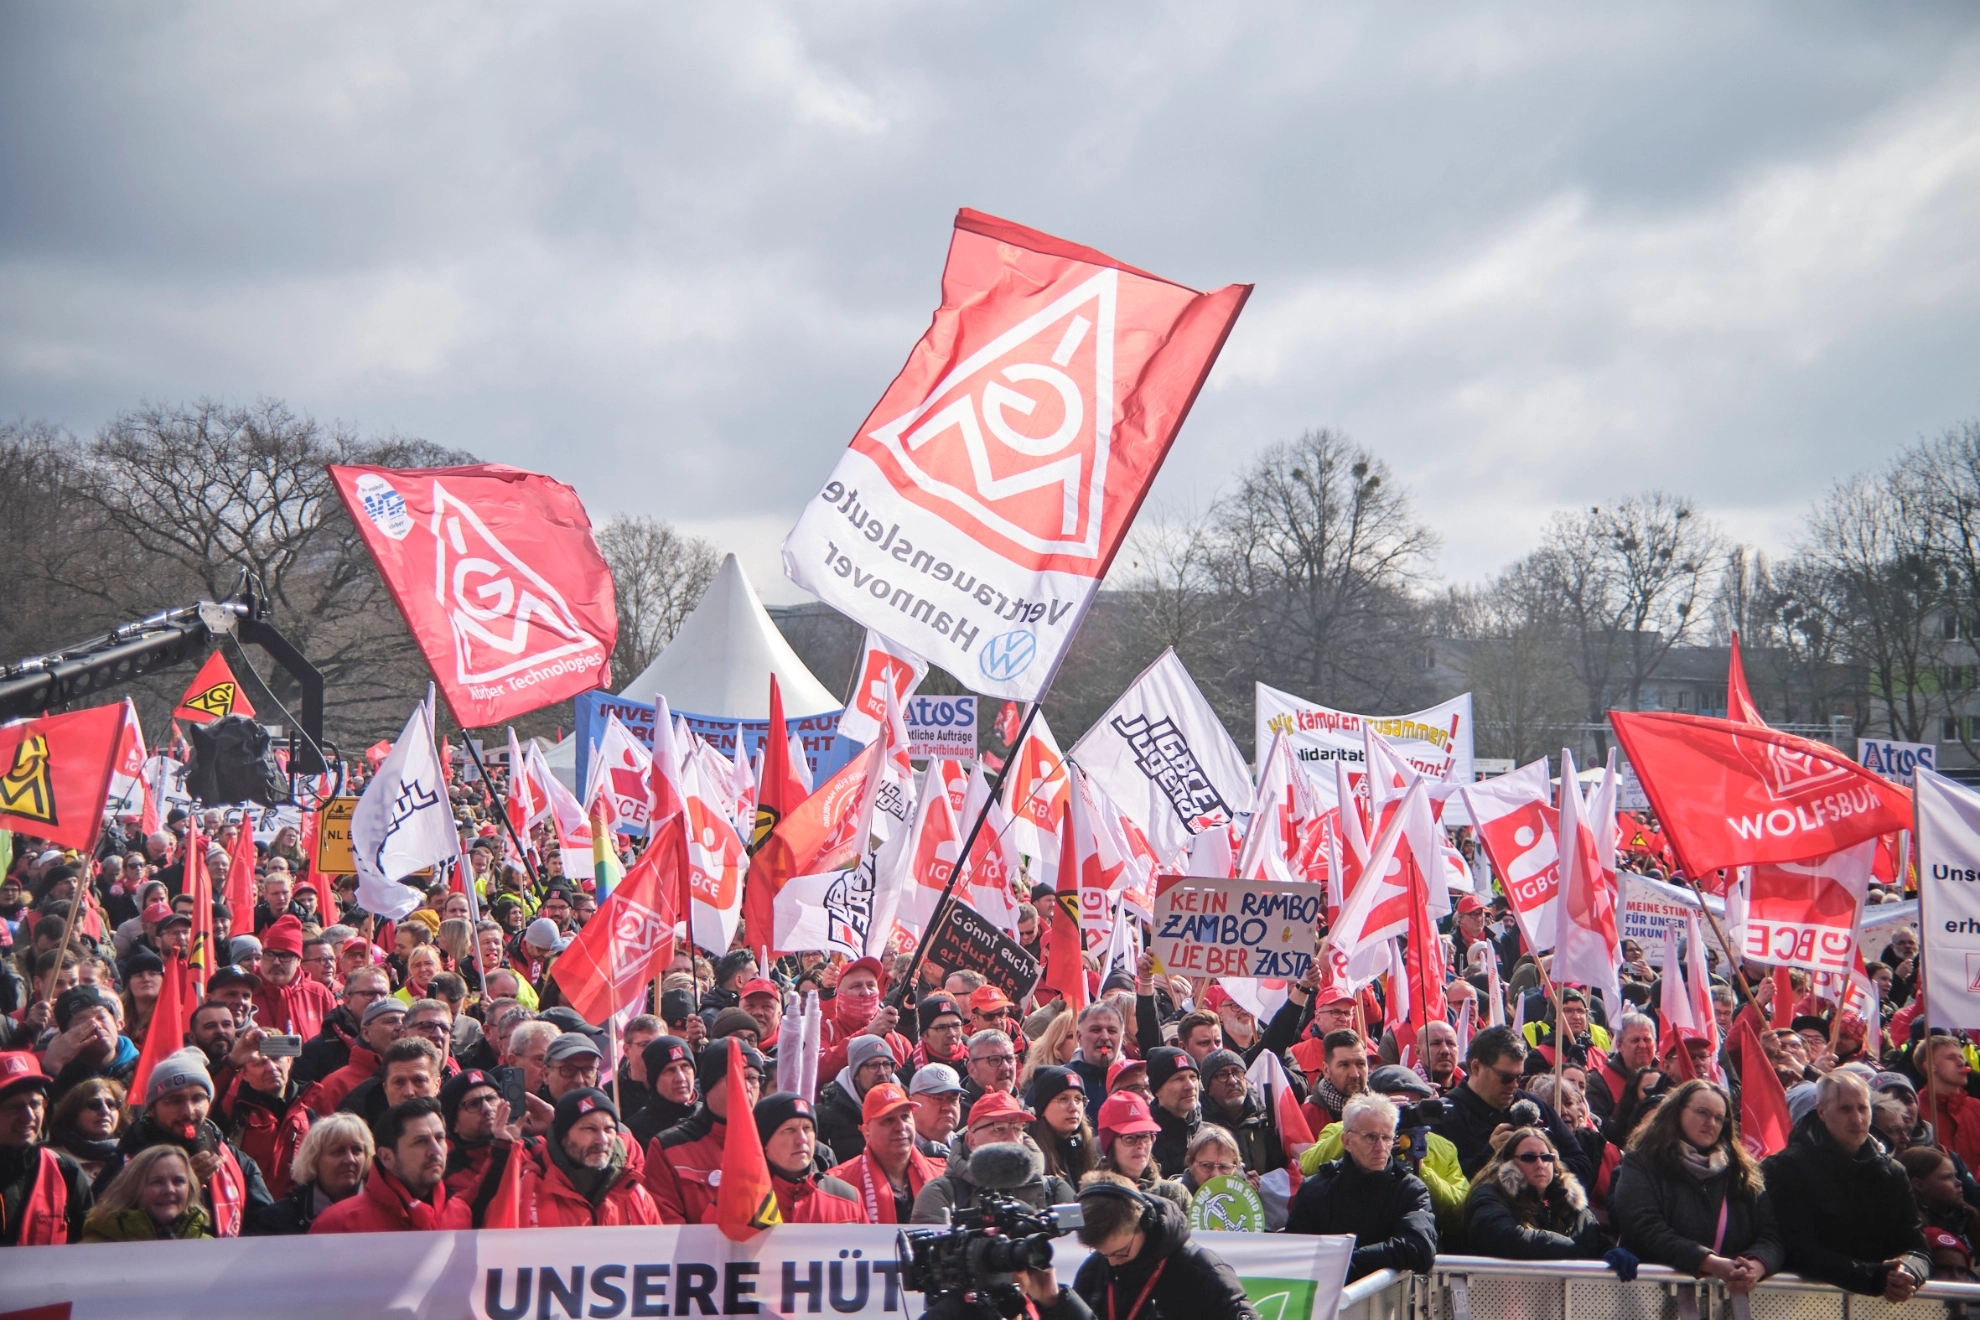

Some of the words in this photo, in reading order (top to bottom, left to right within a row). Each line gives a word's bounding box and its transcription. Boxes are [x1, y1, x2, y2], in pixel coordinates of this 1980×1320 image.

[468, 684, 505, 701] Körber
[505, 652, 603, 692] Technologies
[923, 744, 974, 759] Tarifbindung
[936, 730, 973, 744] Aufträge
[1110, 713, 1206, 820] Jugend
[1149, 715, 1222, 810] IGBCE
[1297, 748, 1364, 763] lidarität
[1170, 891, 1228, 914] KEIN
[1240, 892, 1319, 924] RAMBO
[1625, 912, 1647, 925] FÜR
[1626, 901, 1660, 913] MEINE
[951, 908, 999, 949] Gönnt
[1001, 947, 1034, 978] euch:
[1158, 914, 1268, 946] ZAMBO
[1253, 946, 1313, 980] ZASTA
[1226, 1179, 1244, 1193] WIR
[1243, 1188, 1260, 1212] SIND
[484, 1261, 760, 1320] UNSERE
[781, 1249, 904, 1314] HÜT
